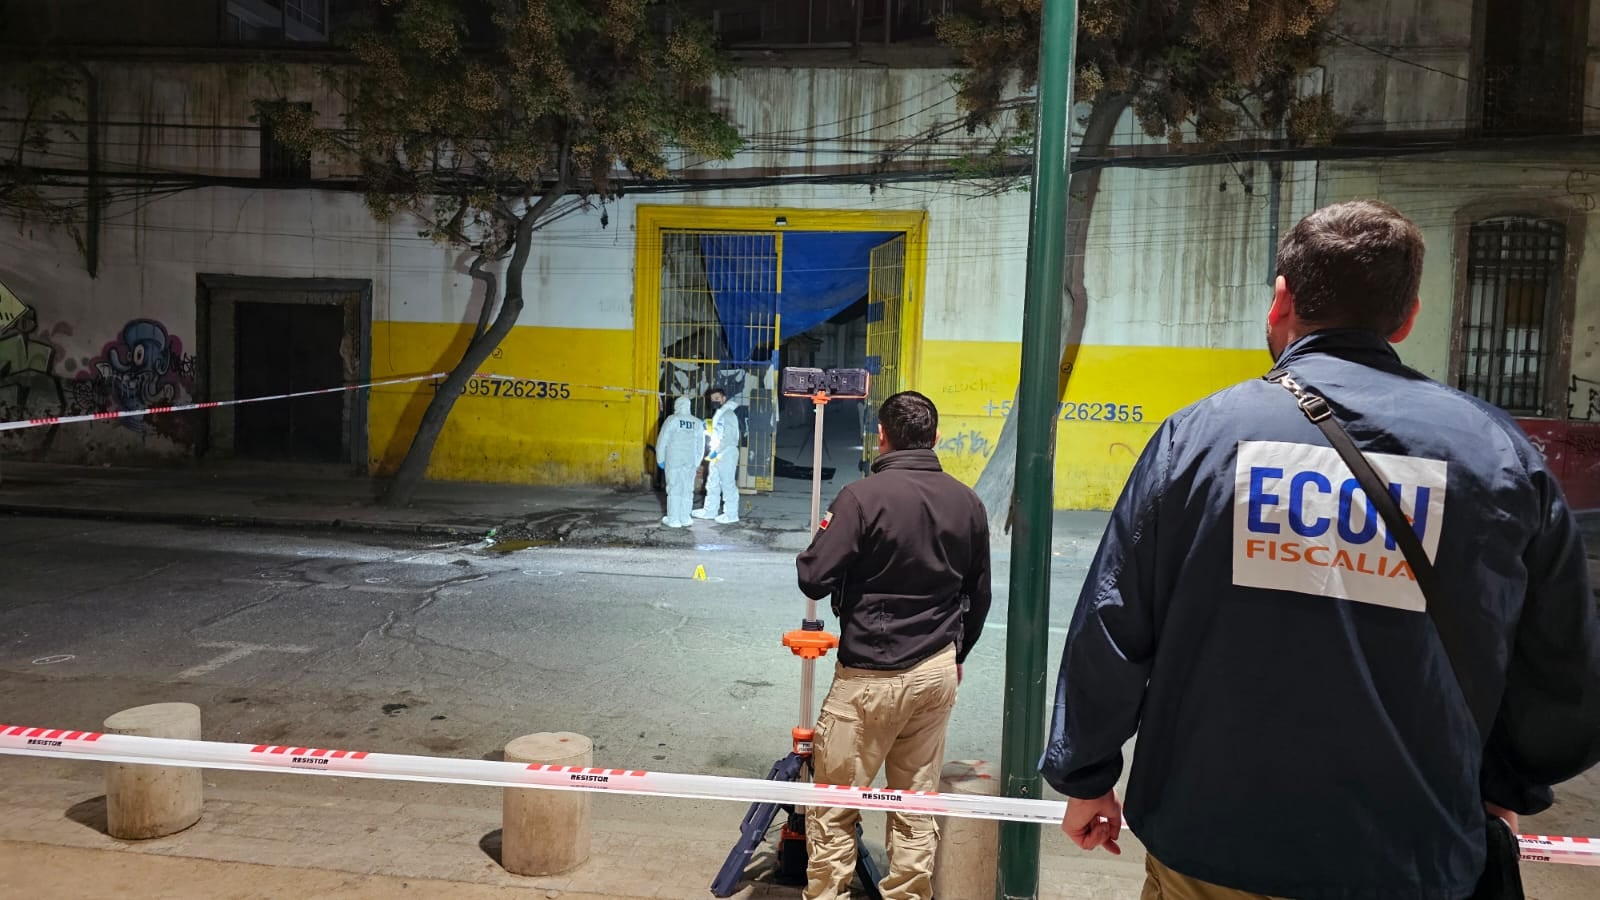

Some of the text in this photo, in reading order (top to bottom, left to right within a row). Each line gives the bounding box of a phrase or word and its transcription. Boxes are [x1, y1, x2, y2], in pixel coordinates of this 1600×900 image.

[1246, 539, 1417, 581] FISCALIA
[292, 757, 329, 765] RESISTOR
[570, 774, 608, 782] RESISTOR
[862, 793, 902, 801] RESISTOR
